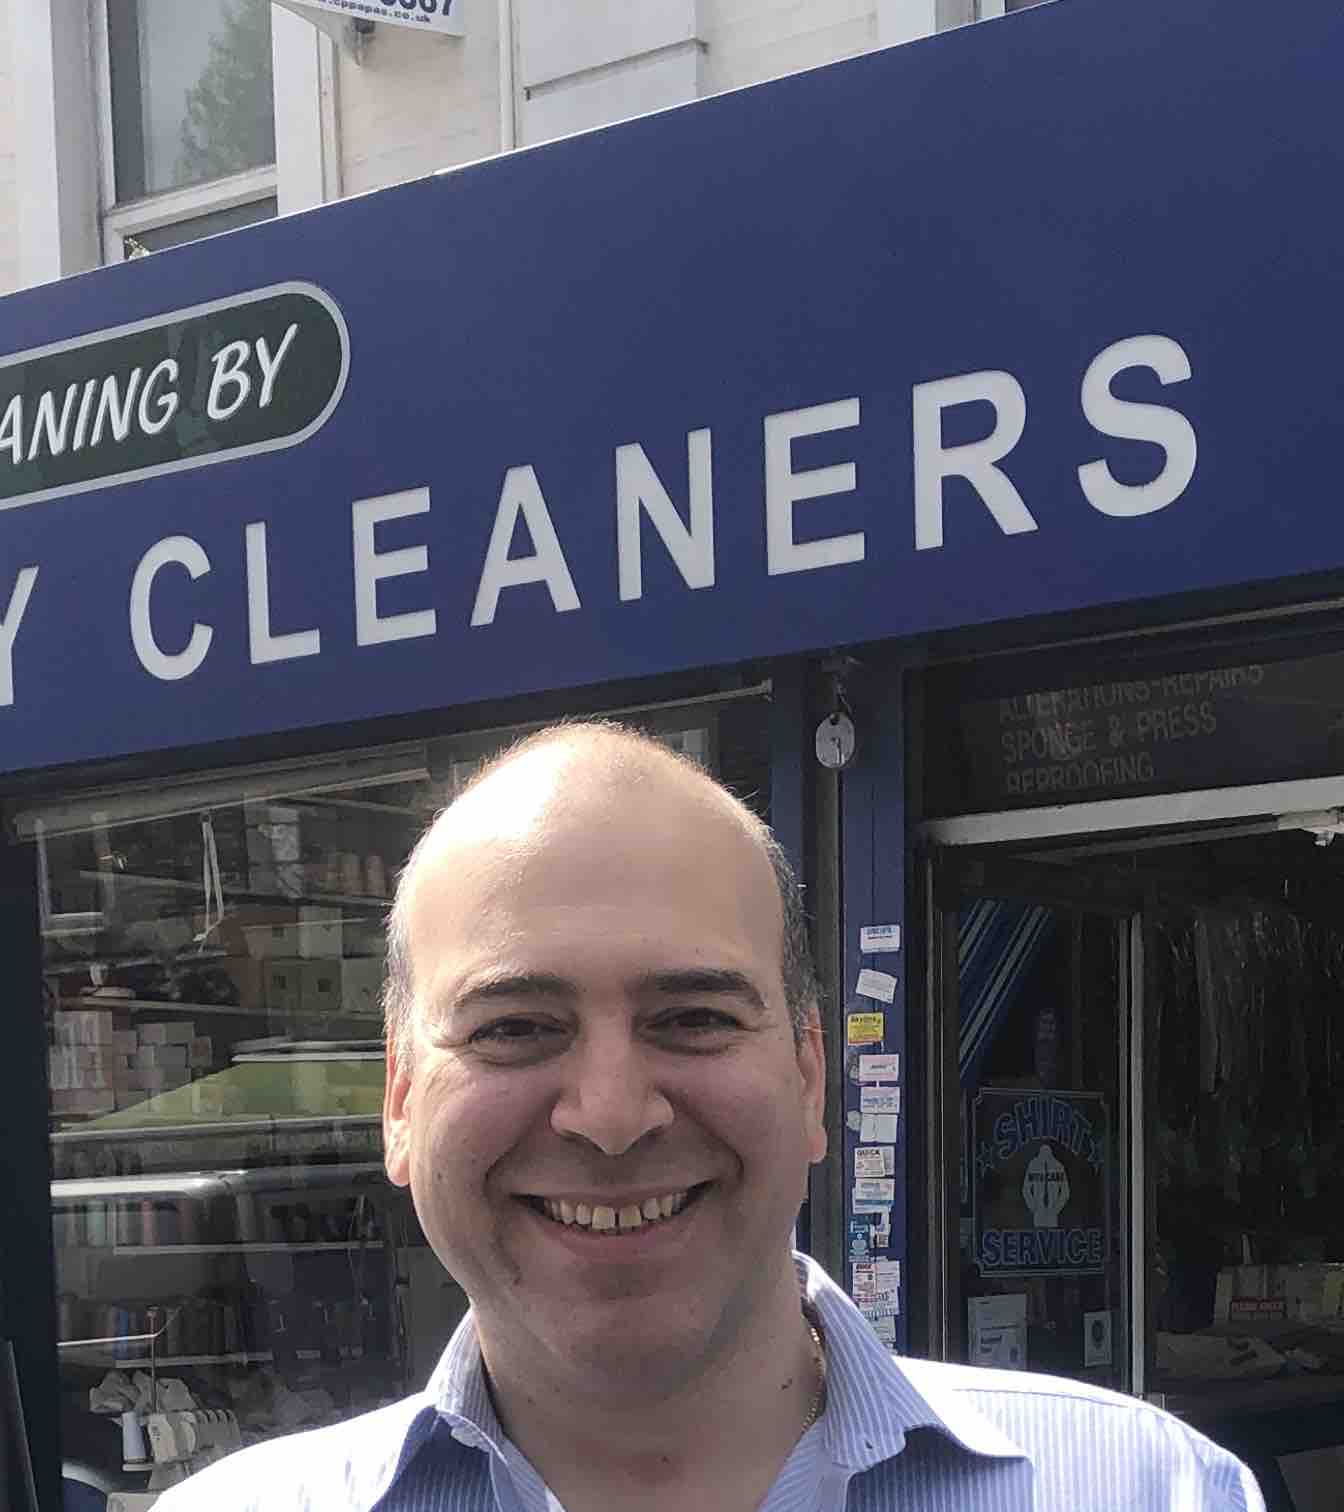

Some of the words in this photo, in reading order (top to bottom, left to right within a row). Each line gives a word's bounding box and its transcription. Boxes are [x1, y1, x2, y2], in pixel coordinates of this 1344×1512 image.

[206, 322, 300, 420] BY
[128, 334, 1199, 682] CLEANERS
[1137, 700, 1218, 745] PRESS
[982, 1229, 1103, 1266] SERVICE
